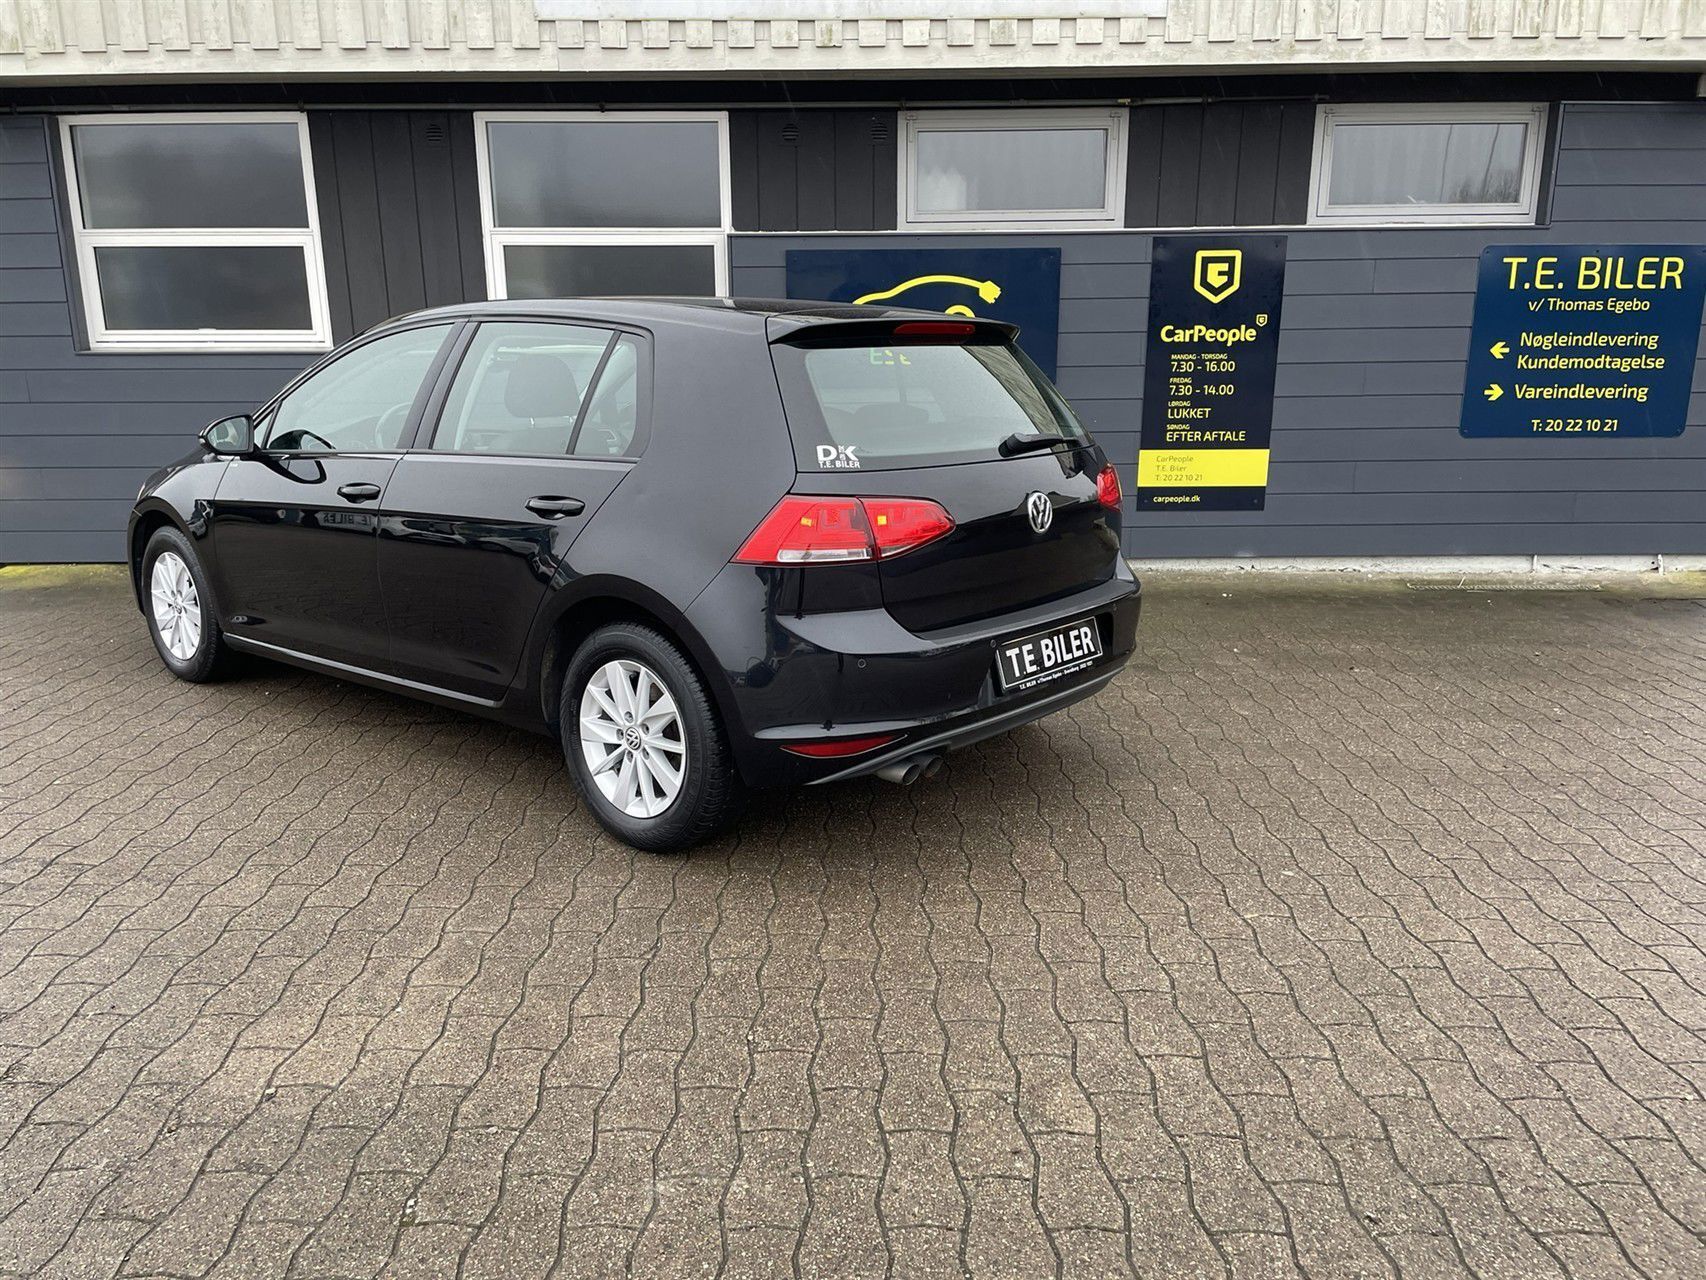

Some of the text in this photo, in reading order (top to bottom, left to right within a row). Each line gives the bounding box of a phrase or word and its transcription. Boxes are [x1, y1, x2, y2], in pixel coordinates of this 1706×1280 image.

[1502, 256, 1685, 290] T.E. BILER
[1528, 297, 1651, 314] v/ Thomas Egebo
[1160, 324, 1257, 347] CarPeople
[1520, 332, 1659, 350] Nøgleindlevering
[1170, 361, 1194, 372] 7.30
[1204, 360, 1236, 372] 16.00
[1517, 354, 1665, 372] Kundemodtagelse
[1169, 384, 1193, 396] 7.30
[1203, 384, 1235, 395] 14.00
[1514, 383, 1649, 402] Vareindlevering
[1167, 408, 1212, 419] LUKKET
[1531, 419, 1618, 432] T: 20 22 10 21
[1166, 430, 1246, 442] EFTER AFTALE
[835, 460, 861, 469] BILER
[1156, 455, 1194, 463] CarPeople
[1195, 473, 1203, 481] 21
[1153, 495, 1201, 504] carpeople.dk
[1005, 626, 1095, 678] T.E. BILER
